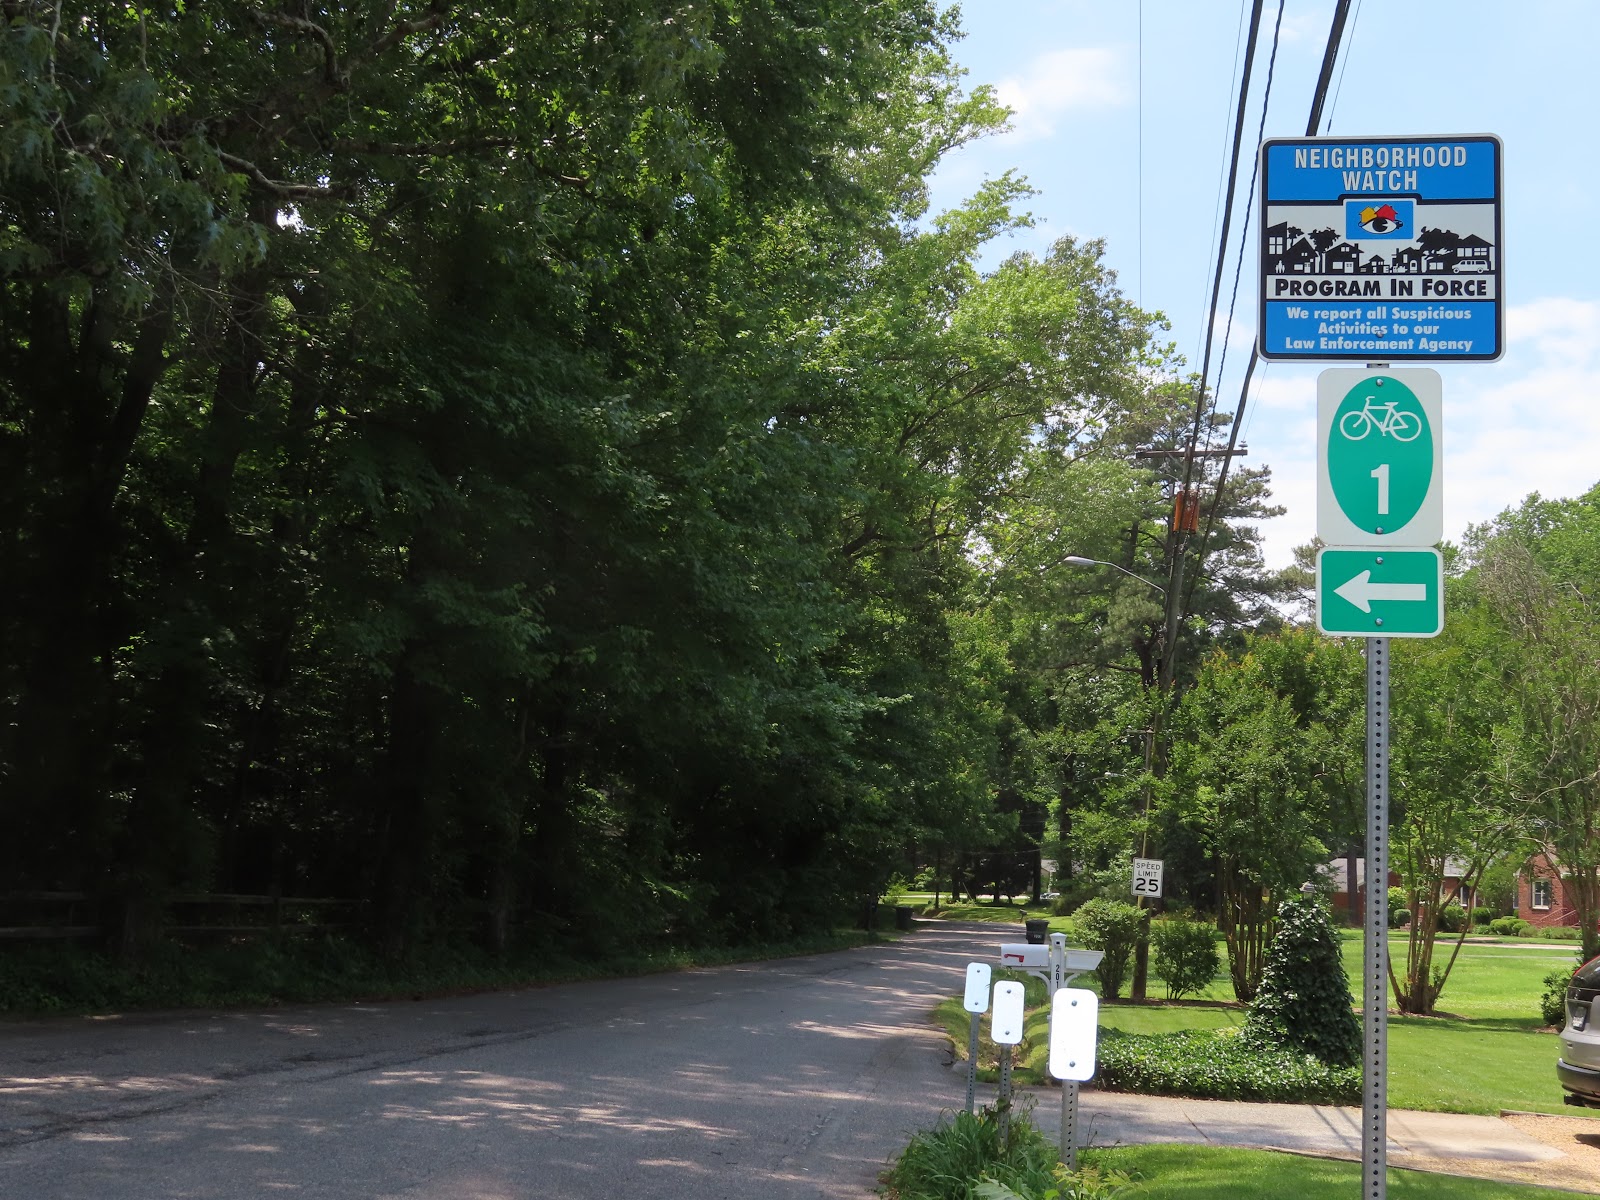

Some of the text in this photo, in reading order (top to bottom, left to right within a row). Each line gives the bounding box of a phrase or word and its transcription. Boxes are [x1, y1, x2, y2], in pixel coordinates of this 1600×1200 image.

[1295, 146, 1467, 169] NEIGHBORHOOD
[1342, 170, 1418, 191] WATCH
[1275, 278, 1487, 296] PROGRAM IN FORCE
[1287, 306, 1472, 322] We report all Suspicious
[1318, 322, 1439, 335] Activities to our
[1285, 337, 1473, 352] Law Enforcement Agency
[1370, 463, 1390, 515] 1
[1136, 862, 1161, 871] SPEED
[1135, 877, 1159, 892] 25
